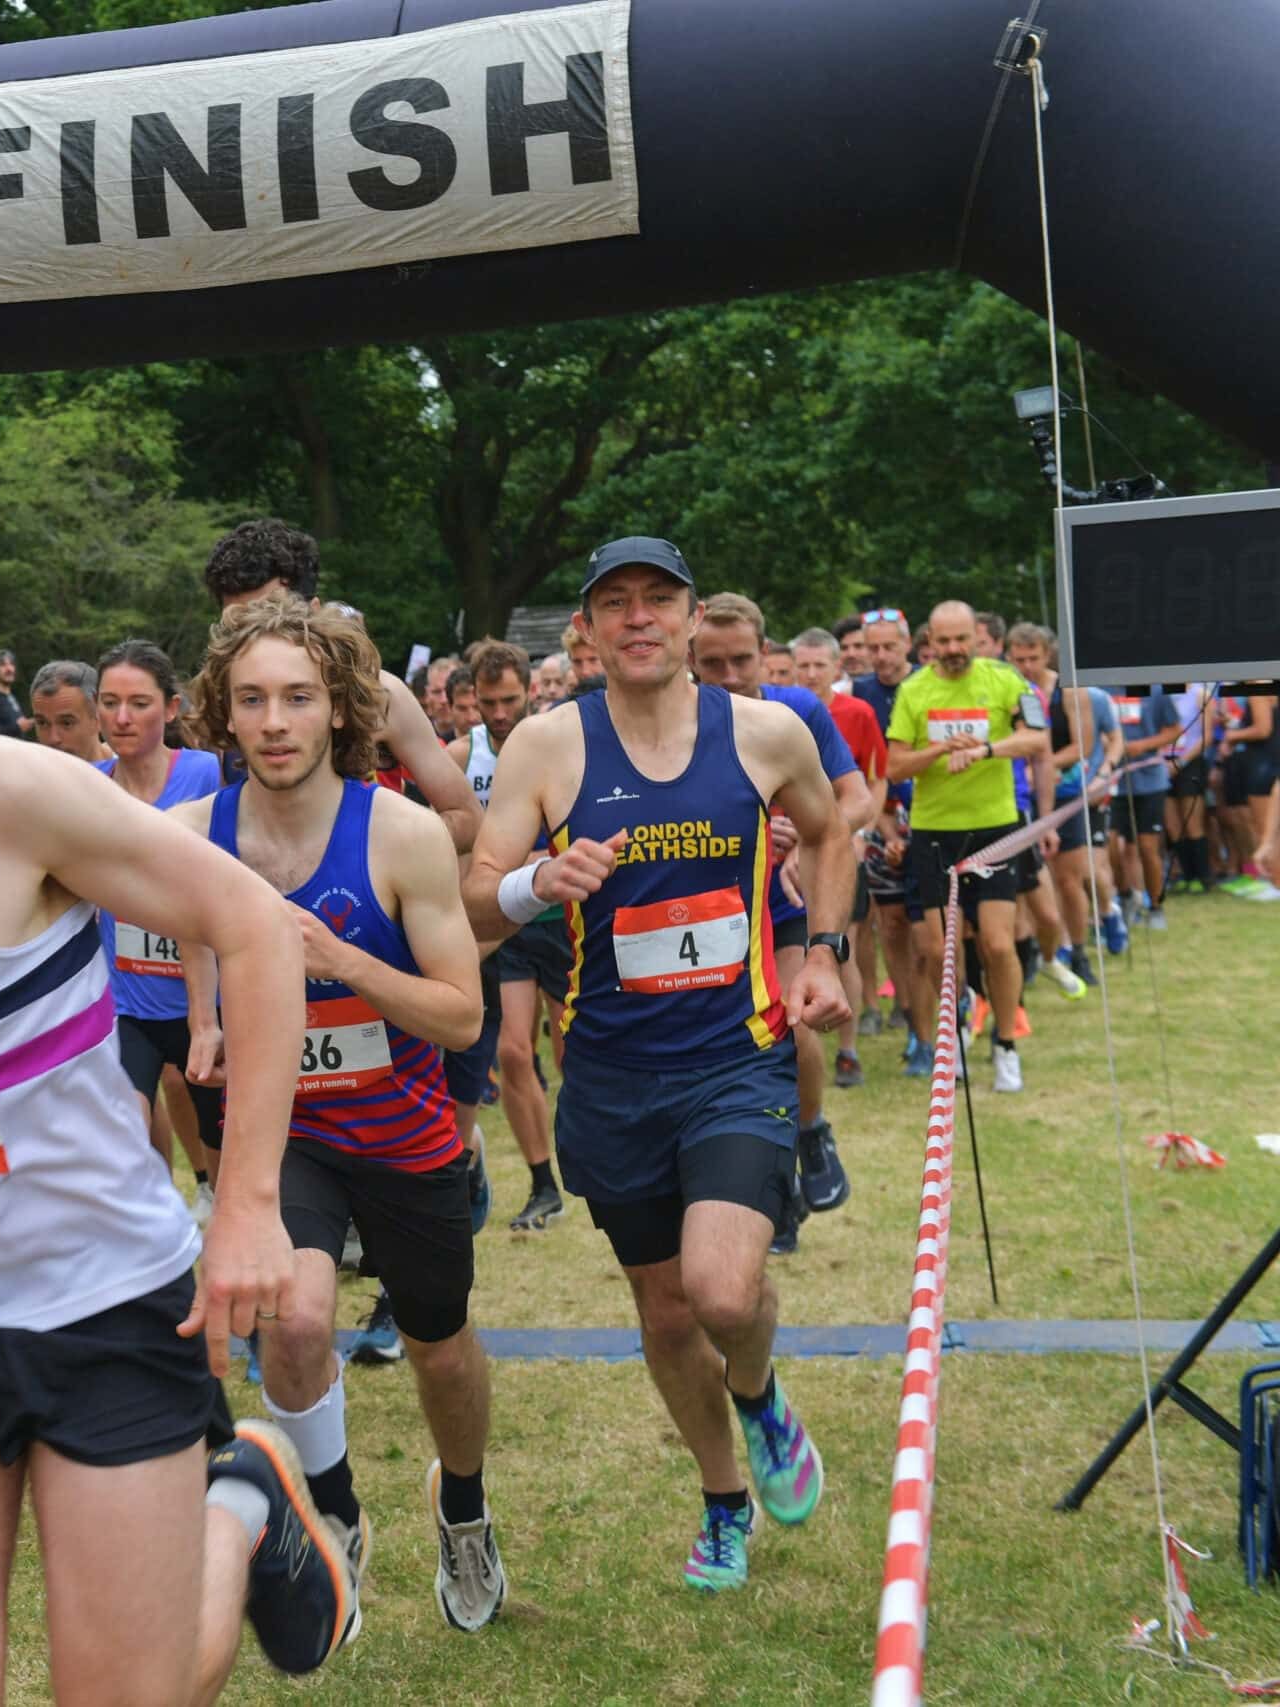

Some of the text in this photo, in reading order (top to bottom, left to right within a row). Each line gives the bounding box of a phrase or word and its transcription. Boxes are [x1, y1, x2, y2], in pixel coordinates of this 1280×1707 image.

[616, 836, 742, 866] EATHSIDE
[679, 931, 700, 967] 4
[658, 972, 725, 989] I'm just running
[301, 1034, 342, 1072] 86
[304, 1081, 320, 1091] just
[322, 1077, 357, 1088] running
